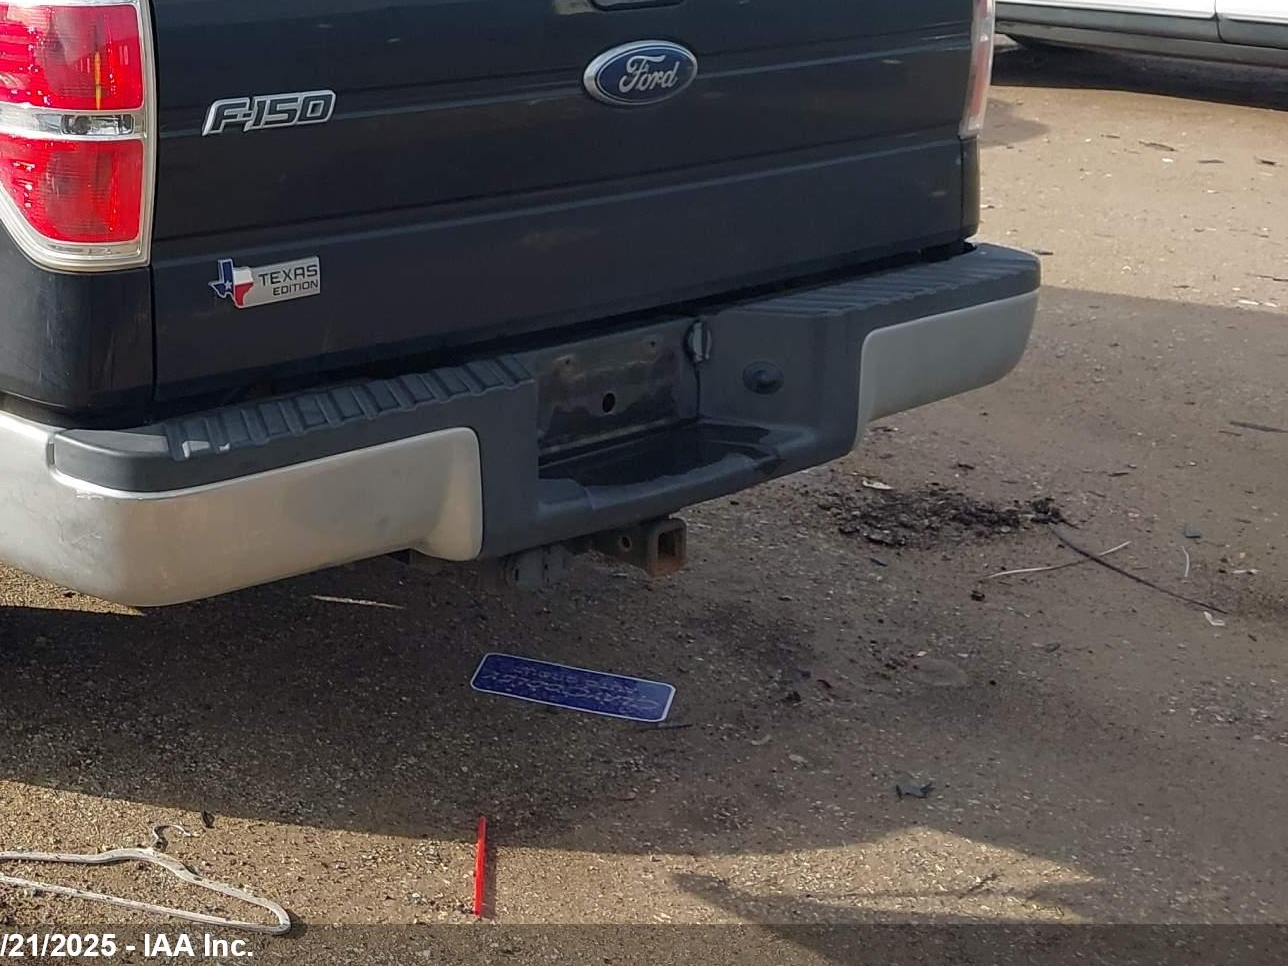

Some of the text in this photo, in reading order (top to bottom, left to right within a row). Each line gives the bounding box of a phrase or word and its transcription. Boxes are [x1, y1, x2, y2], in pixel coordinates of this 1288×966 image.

[618, 54, 680, 93] Ford
[258, 264, 318, 286] TEXAS
[272, 279, 319, 296] EDITION
